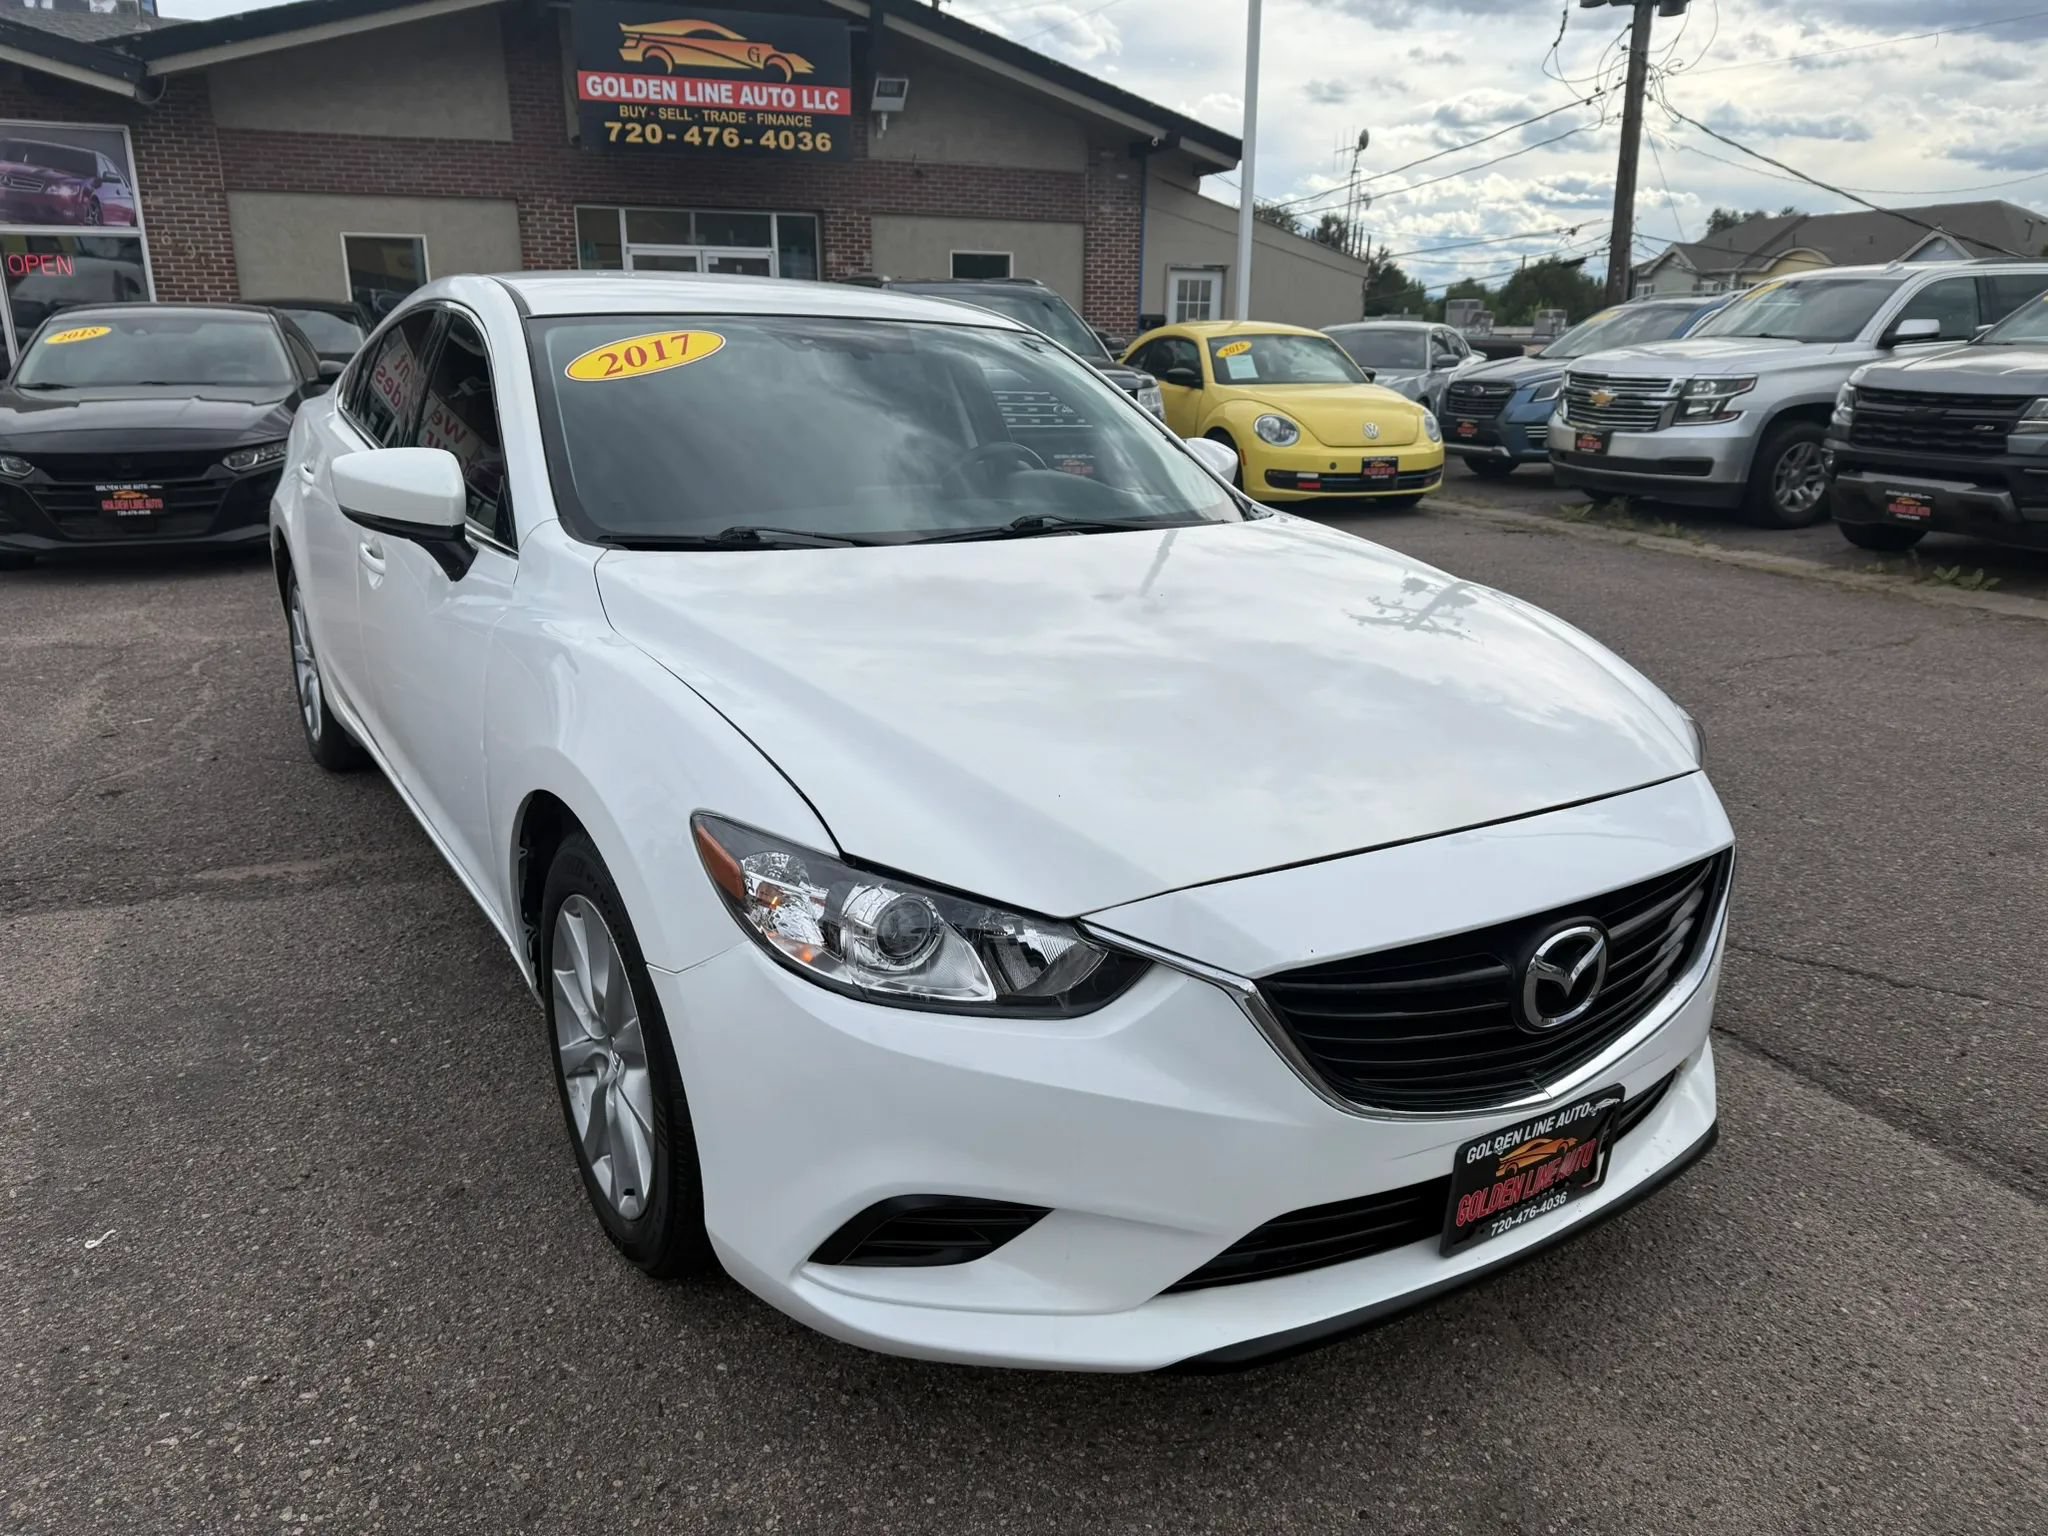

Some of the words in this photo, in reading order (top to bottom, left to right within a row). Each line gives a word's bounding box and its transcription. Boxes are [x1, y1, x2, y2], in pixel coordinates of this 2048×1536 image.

[586, 76, 677, 101] GOLDEN
[684, 83, 733, 105] LINE
[740, 85, 795, 108] AUTO
[802, 90, 839, 111] LLC
[619, 105, 647, 119] BUY
[658, 107, 692, 121] SELL
[702, 110, 746, 124] TRADE
[757, 113, 812, 127] FINANCE
[8, 254, 74, 277] OPEN
[598, 334, 689, 376] 2017
[1224, 343, 1246, 355] 2015
[1467, 1128, 1523, 1164] GOLDEN
[1524, 1116, 1554, 1140] LINE
[1555, 1102, 1590, 1129] AUTO
[1456, 1173, 1525, 1227] GOLDEN
[1522, 1157, 1561, 1200] LINE
[1555, 1138, 1597, 1182] AUTO
[1491, 1191, 1568, 1237] 720-476-4036
